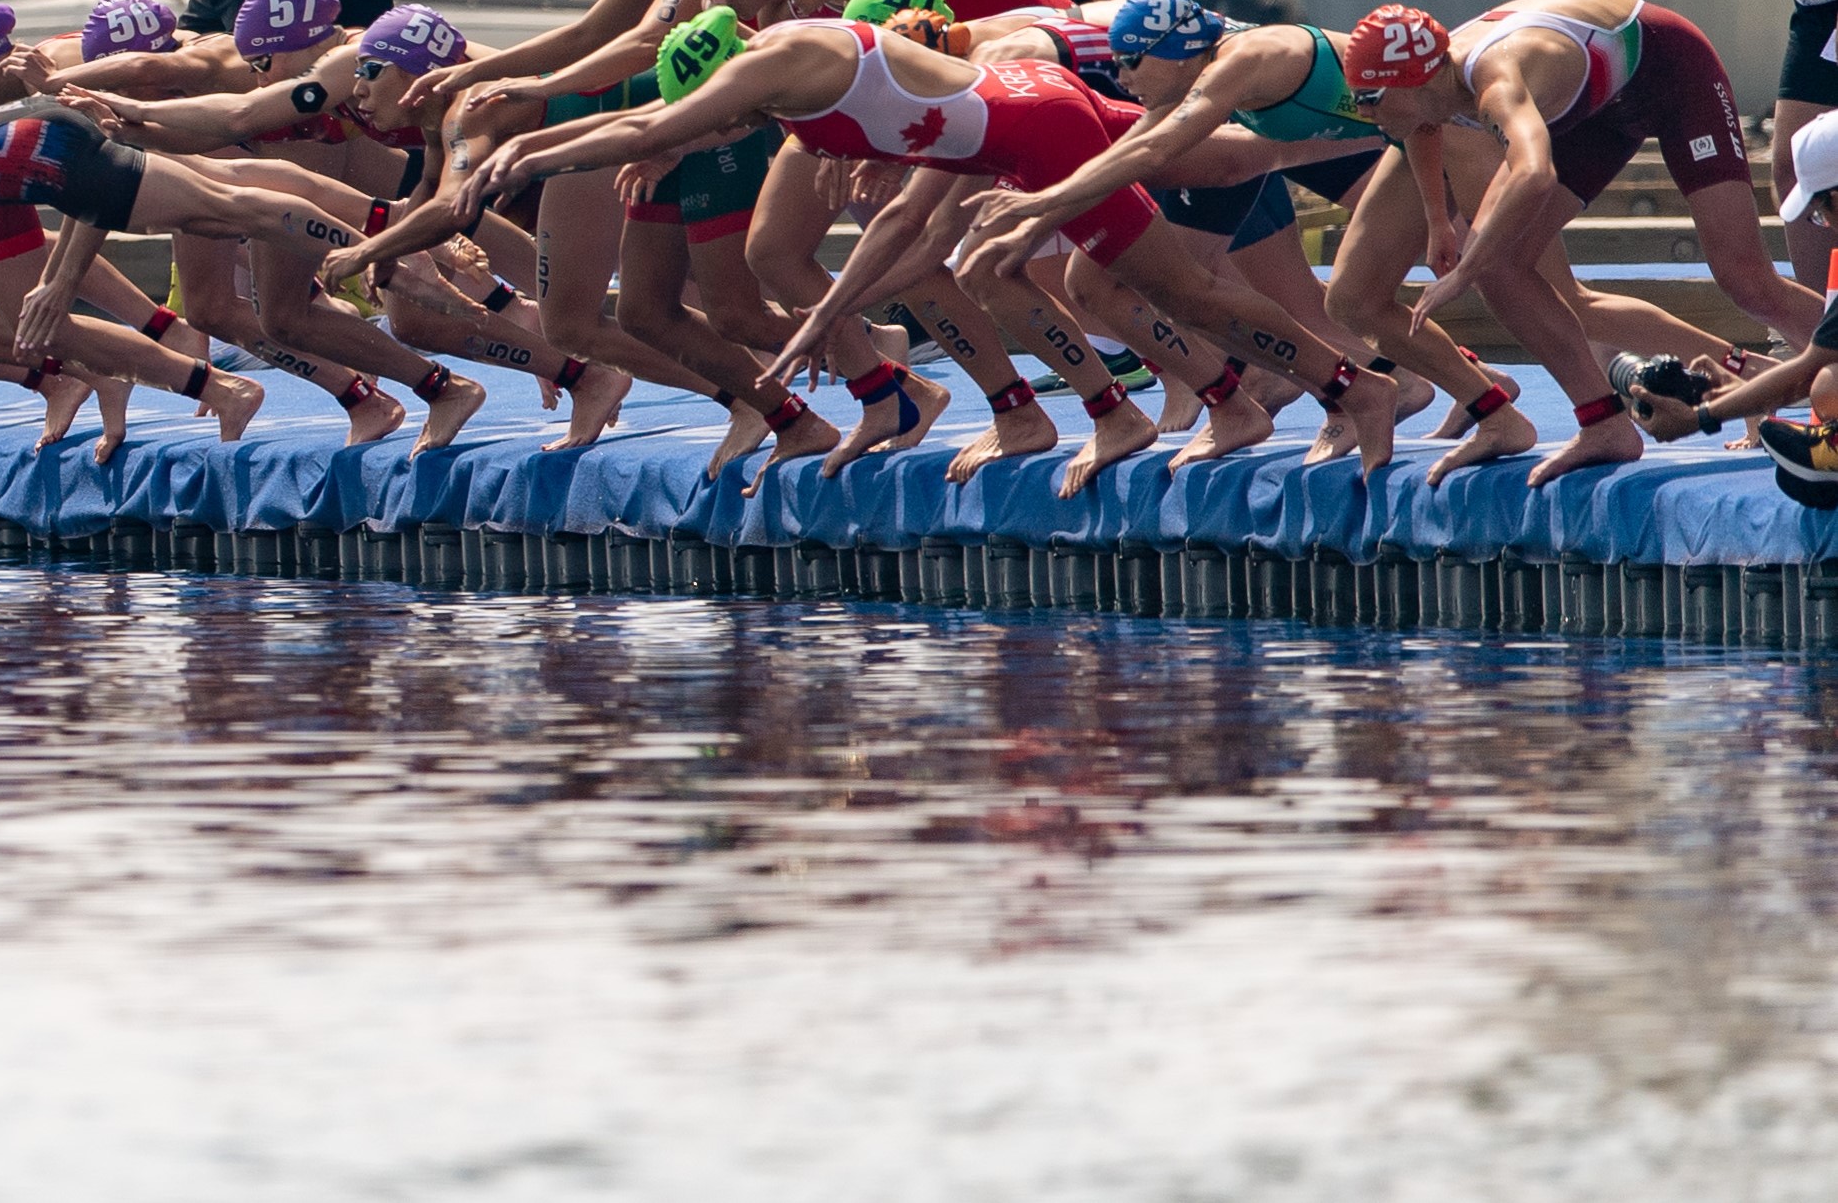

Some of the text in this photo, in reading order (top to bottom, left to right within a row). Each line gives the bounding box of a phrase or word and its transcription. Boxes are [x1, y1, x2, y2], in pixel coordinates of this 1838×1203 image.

[106, 1, 161, 44] 56
[265, 35, 285, 44] NTT
[400, 12, 456, 59] 59
[1383, 22, 1437, 62] 25
[387, 44, 410, 56] NTT
[669, 28, 721, 87] 49
[1377, 70, 1399, 78] NTT
[1713, 81, 1737, 132] SWISS
[305, 217, 351, 248] 62
[538, 254, 551, 299] 57
[485, 342, 533, 367] 56
[936, 318, 977, 360] 58
[1043, 324, 1086, 367] 50
[1151, 318, 1191, 359] 47
[1251, 329, 1298, 362] 49
[272, 349, 319, 378] 52
